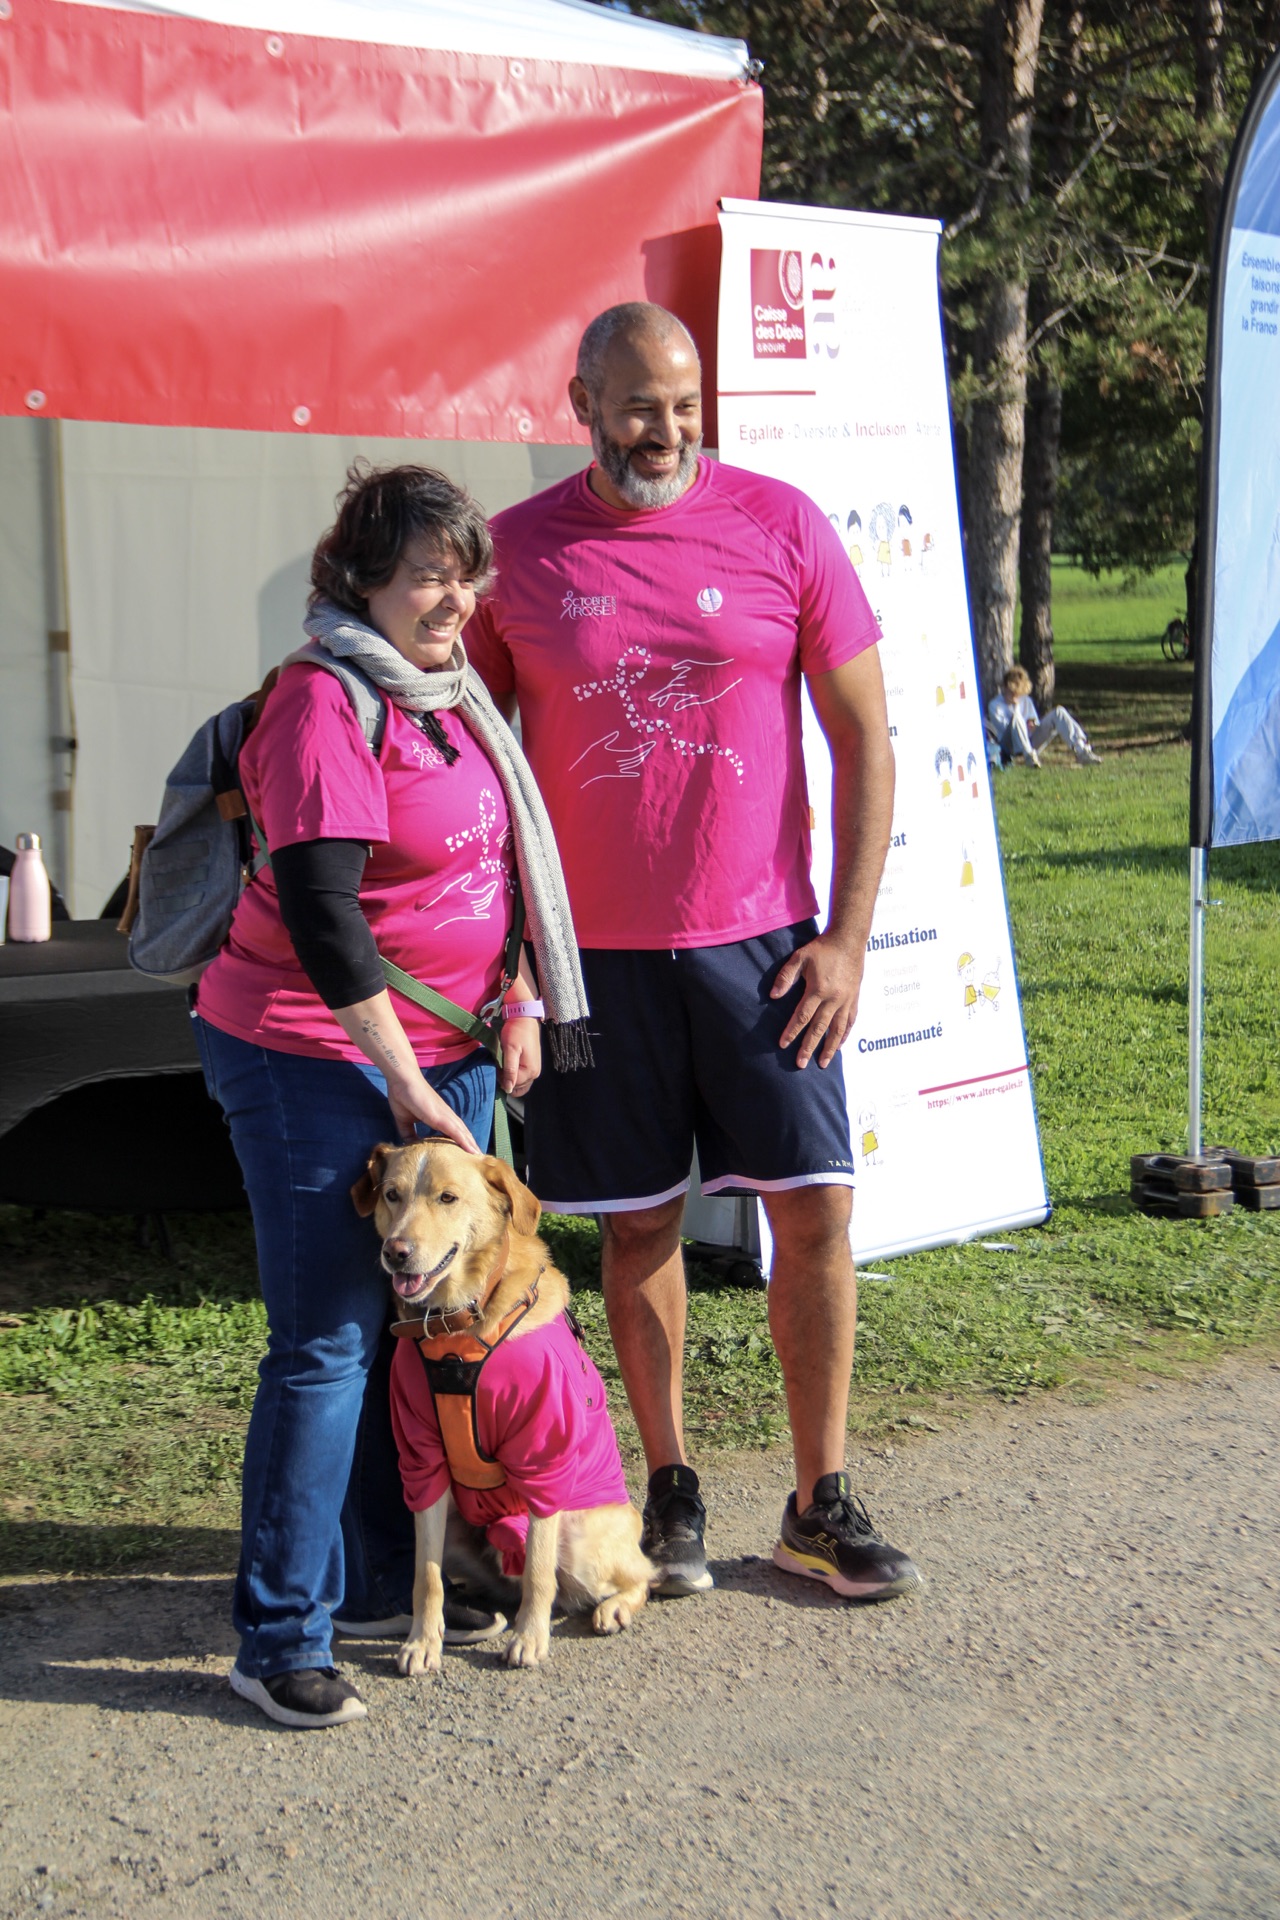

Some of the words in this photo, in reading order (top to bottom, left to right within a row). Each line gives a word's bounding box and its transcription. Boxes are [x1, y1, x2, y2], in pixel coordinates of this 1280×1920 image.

[754, 304, 787, 321] Caisse
[1250, 299, 1279, 315] grandir
[755, 323, 774, 340] des
[1242, 316, 1249, 331] la
[1251, 317, 1278, 336] France
[855, 421, 907, 438] Inclusion
[573, 604, 612, 617] ROSE
[858, 1022, 943, 1053] Communauté
